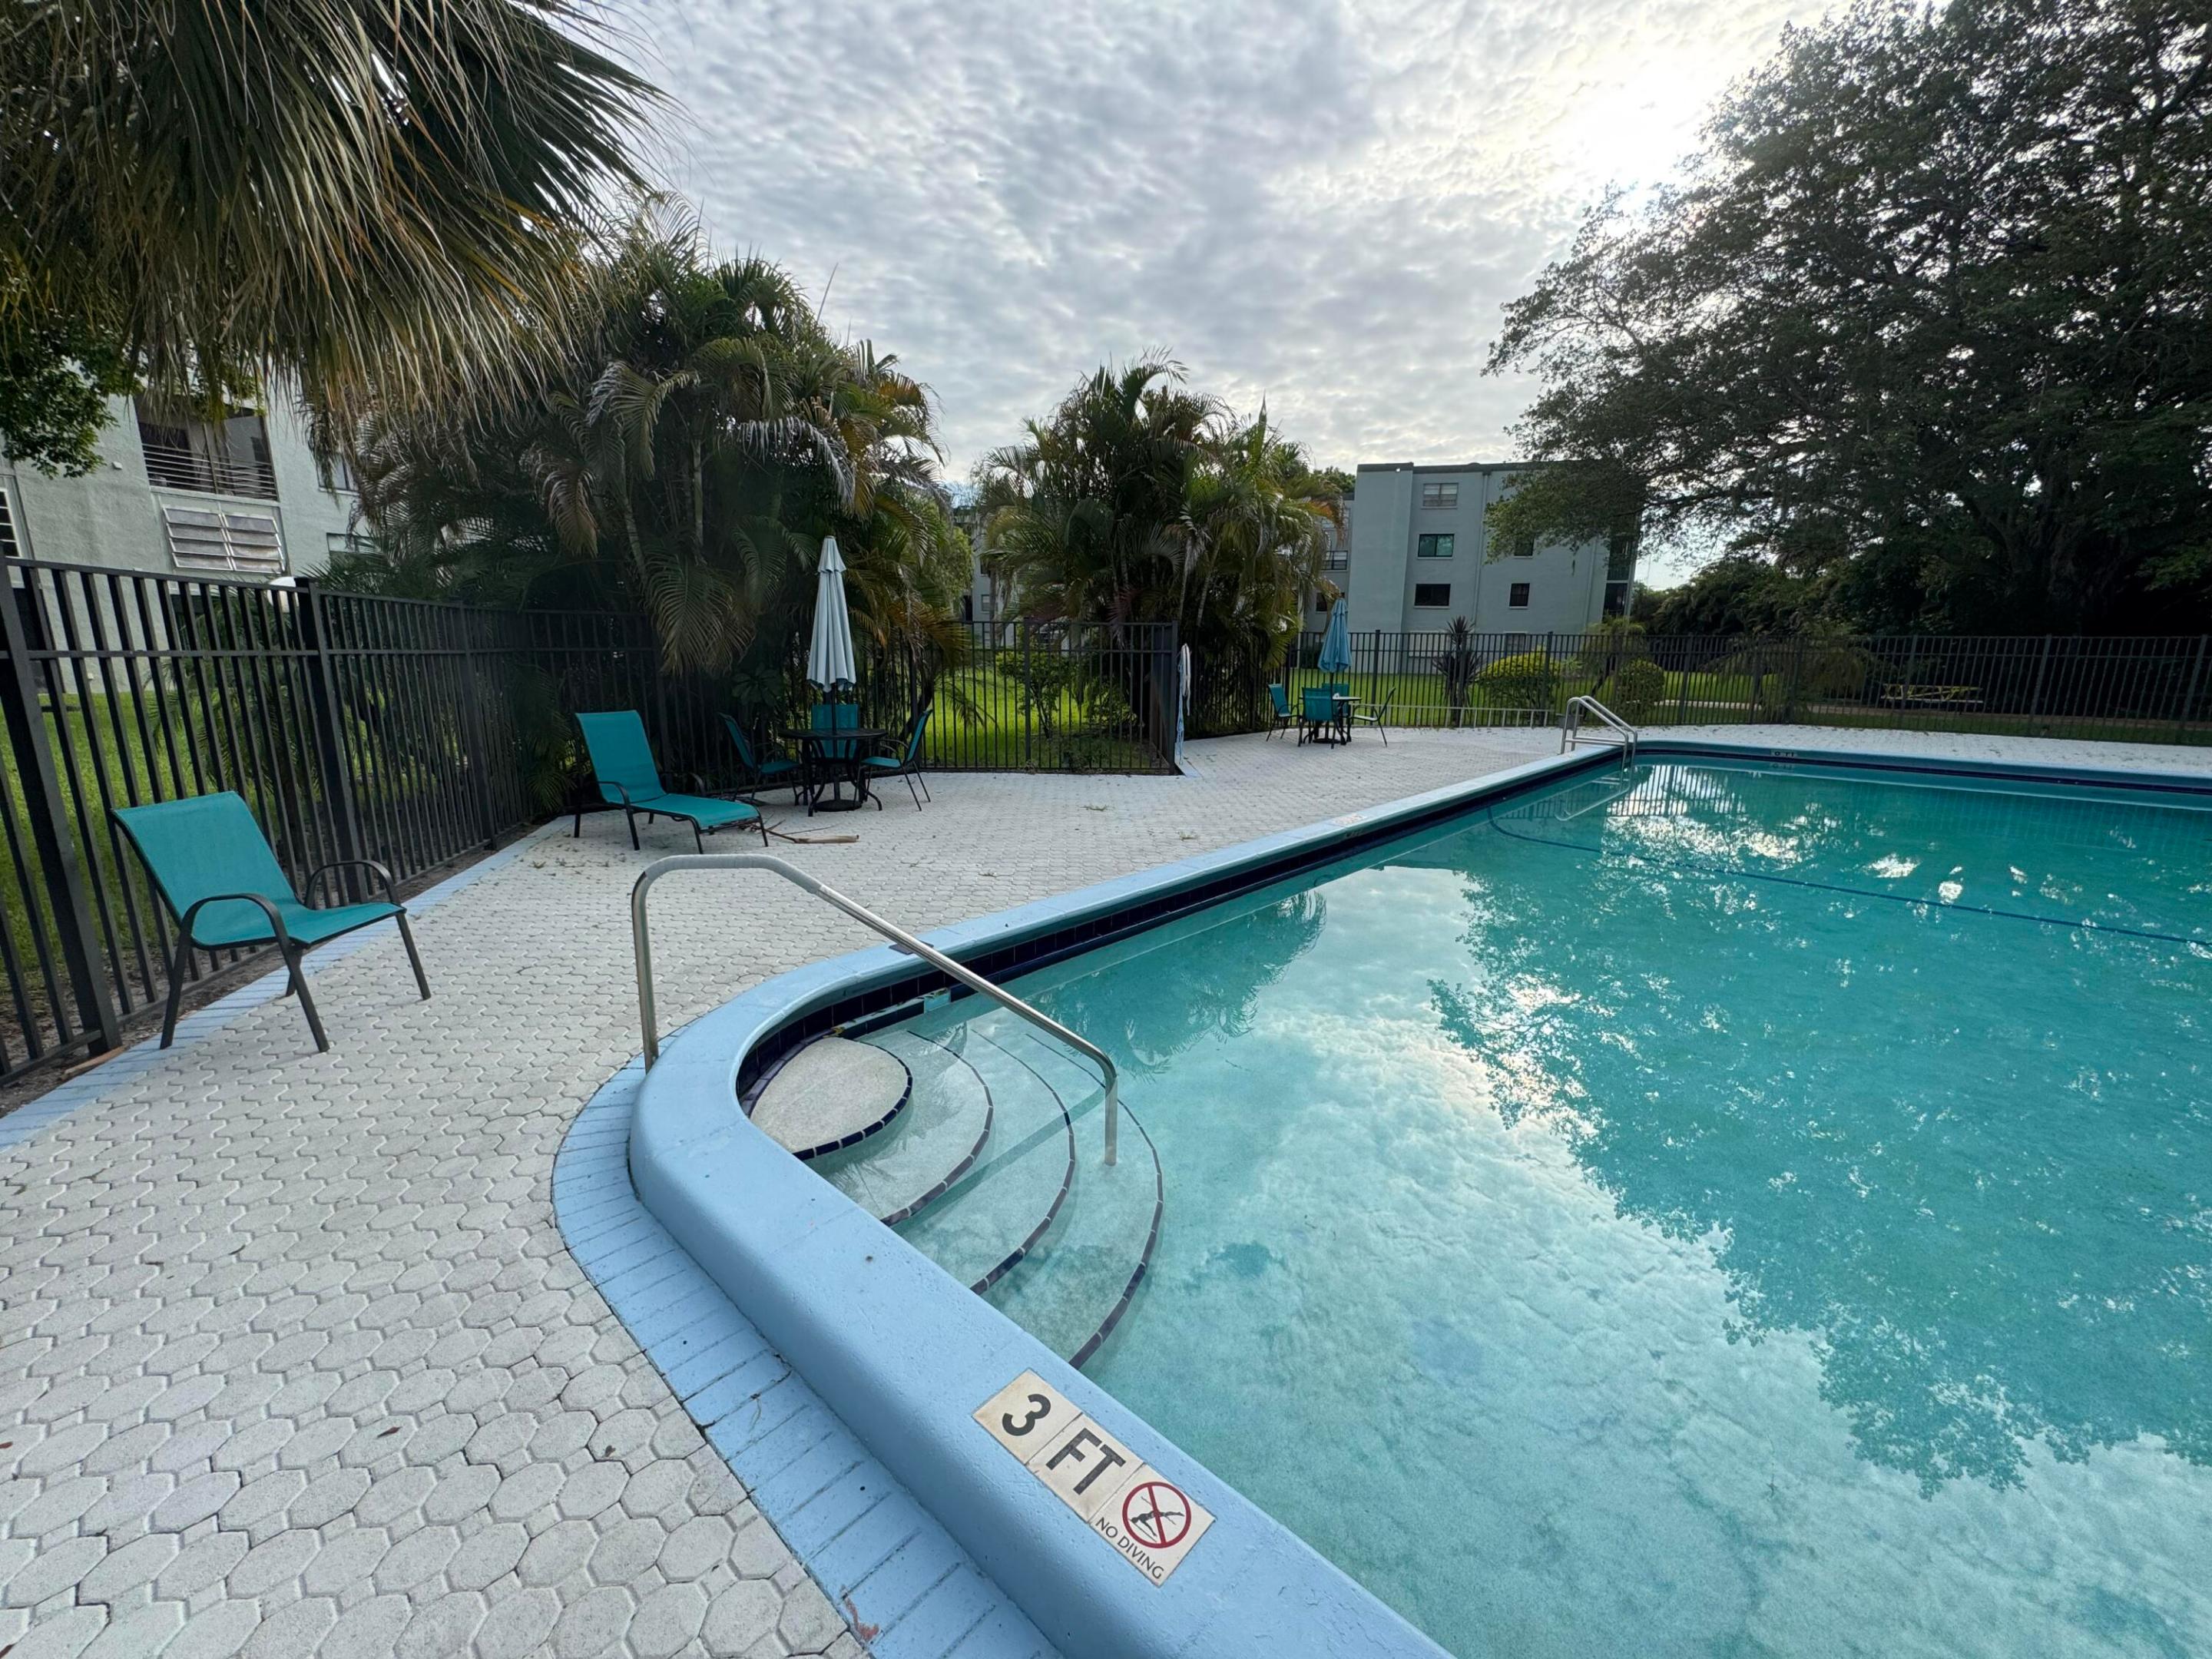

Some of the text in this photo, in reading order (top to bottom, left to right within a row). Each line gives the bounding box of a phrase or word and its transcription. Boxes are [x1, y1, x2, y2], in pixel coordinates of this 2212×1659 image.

[1002, 1393, 1126, 1495] 3 FT
[1096, 1517, 1164, 1579] NO DIVING
